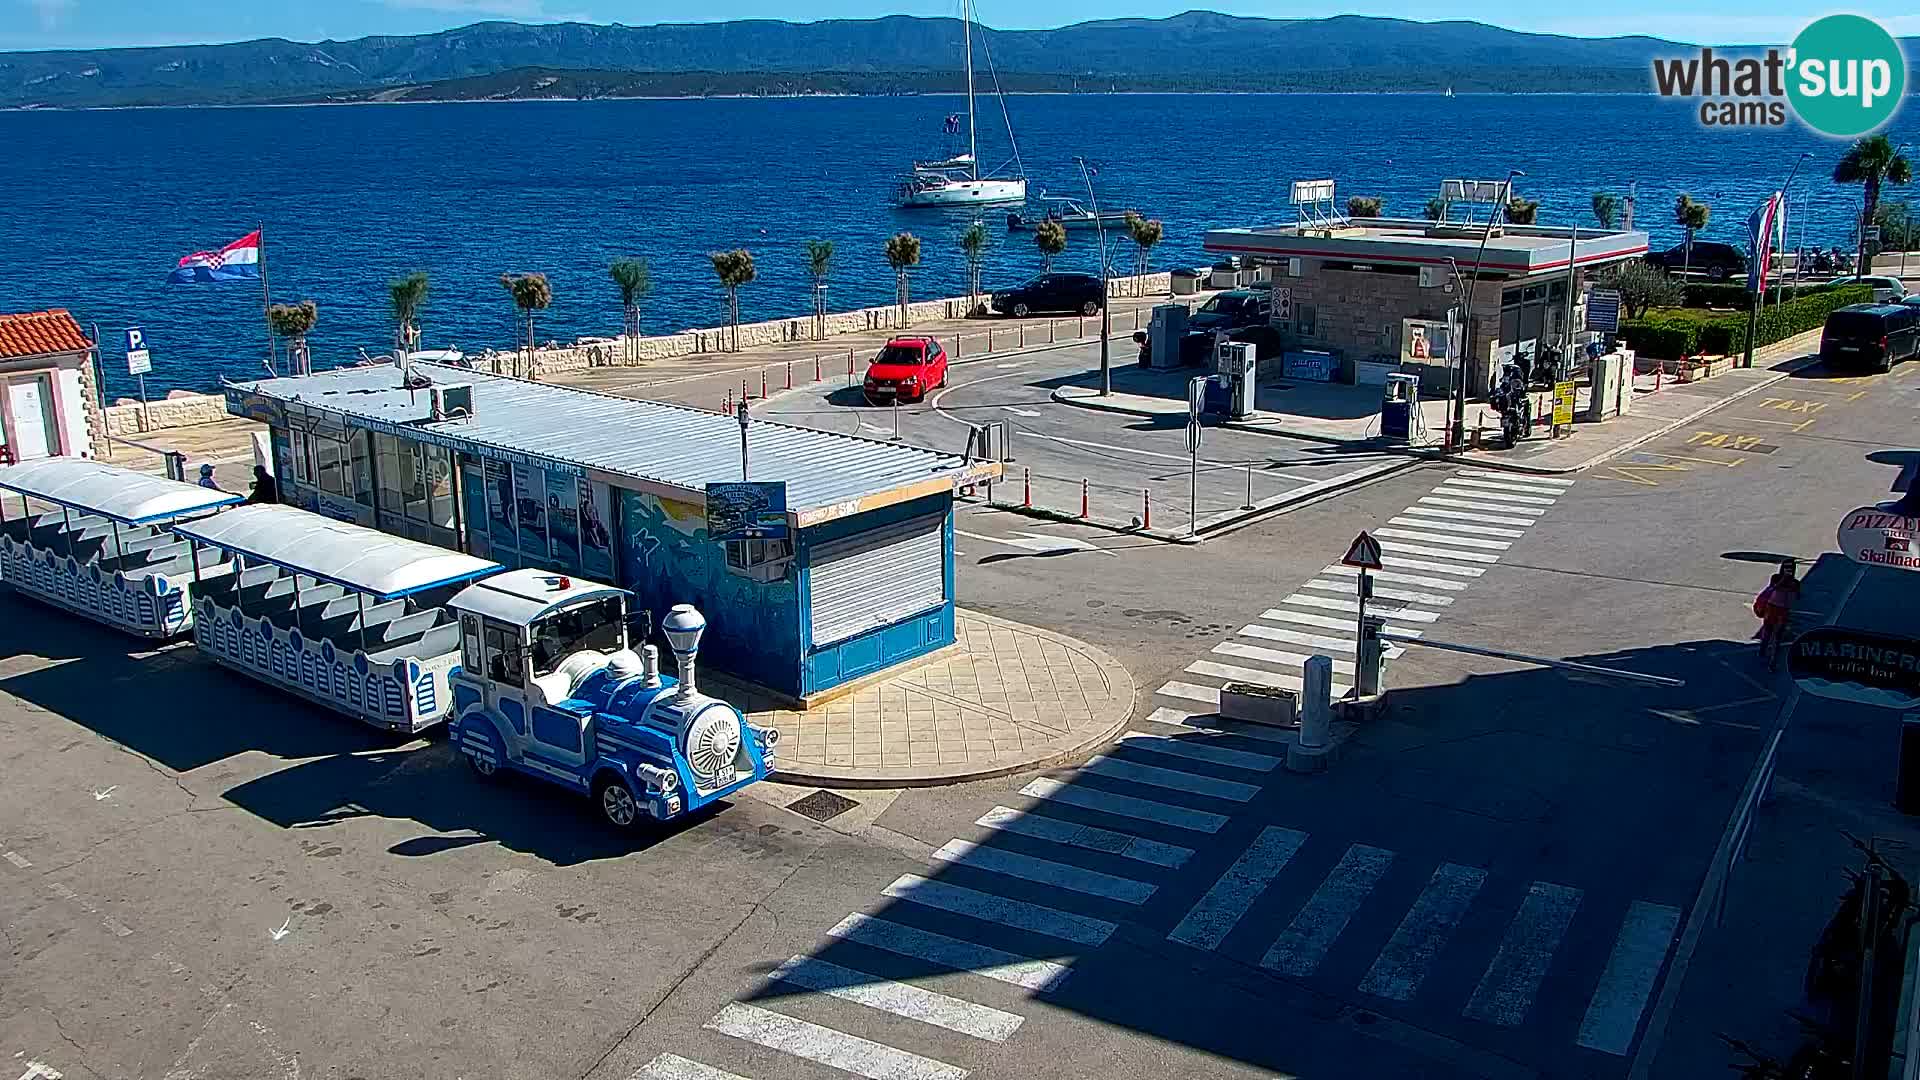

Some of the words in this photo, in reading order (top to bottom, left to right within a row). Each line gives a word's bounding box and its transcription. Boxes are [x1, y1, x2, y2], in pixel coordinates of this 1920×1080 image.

[129, 330, 142, 349] P
[1759, 397, 1828, 414] TAXI
[1686, 431, 1764, 450] TAXI
[478, 445, 493, 456] BUS
[494, 449, 526, 464] STATION
[528, 456, 554, 470] TICKET
[555, 461, 582, 477] OFFICE
